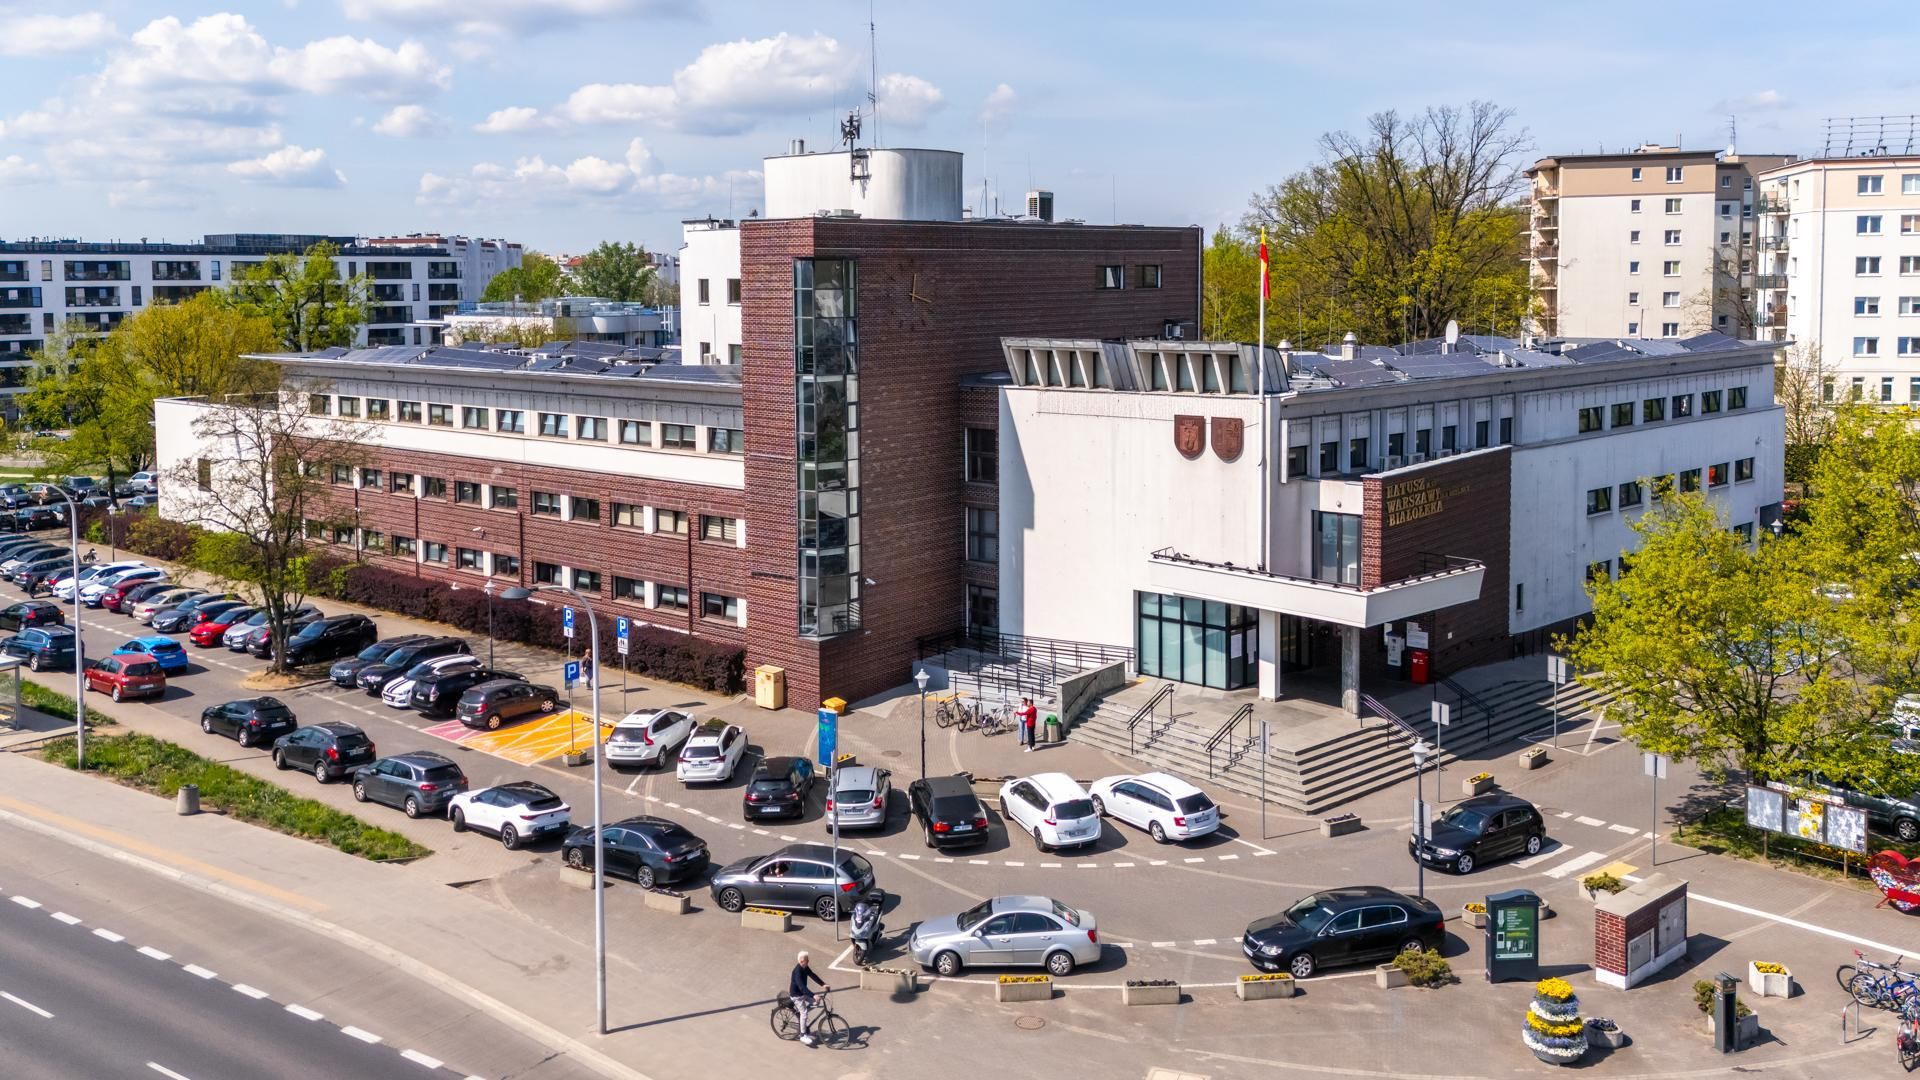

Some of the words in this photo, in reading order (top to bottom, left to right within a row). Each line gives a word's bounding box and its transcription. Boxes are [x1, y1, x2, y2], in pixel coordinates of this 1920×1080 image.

[1386, 478, 1425, 498] RATUSZ
[1387, 487, 1441, 513] WARSZAWY
[565, 609, 572, 622] P
[619, 619, 626, 632] P
[567, 663, 577, 679] P
